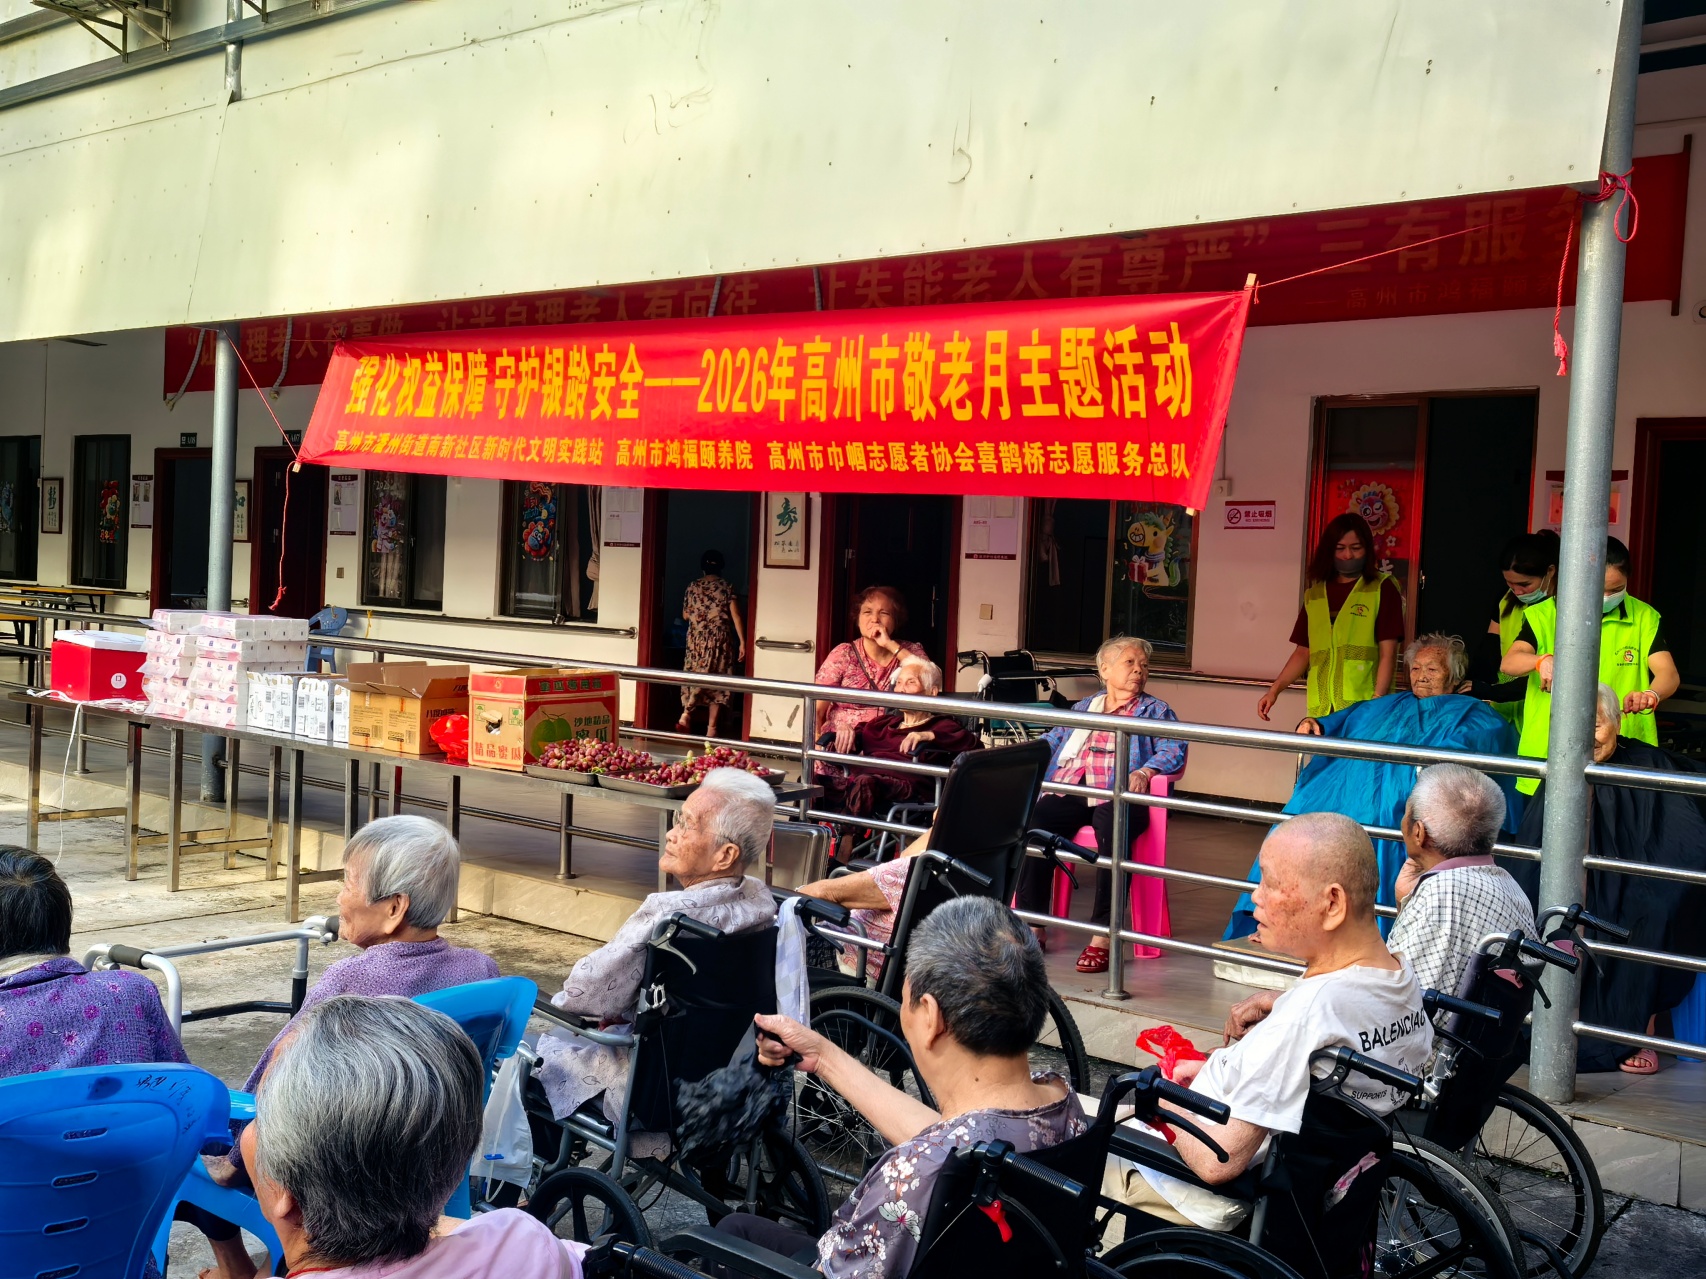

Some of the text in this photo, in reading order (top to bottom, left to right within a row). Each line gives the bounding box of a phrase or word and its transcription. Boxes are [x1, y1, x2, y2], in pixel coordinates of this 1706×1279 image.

[345, 347, 489, 419] 强化权益保障
[616, 438, 754, 470] 高州市鸿福颐养院
[767, 440, 1191, 480] 高州市巾帼志愿者协会喜鹊桥志愿服务总队
[1244, 510, 1272, 518] 禁止吸烟
[475, 742, 522, 761] 精品蜜瓜
[1351, 1089, 1388, 1100] SUPPORTS
